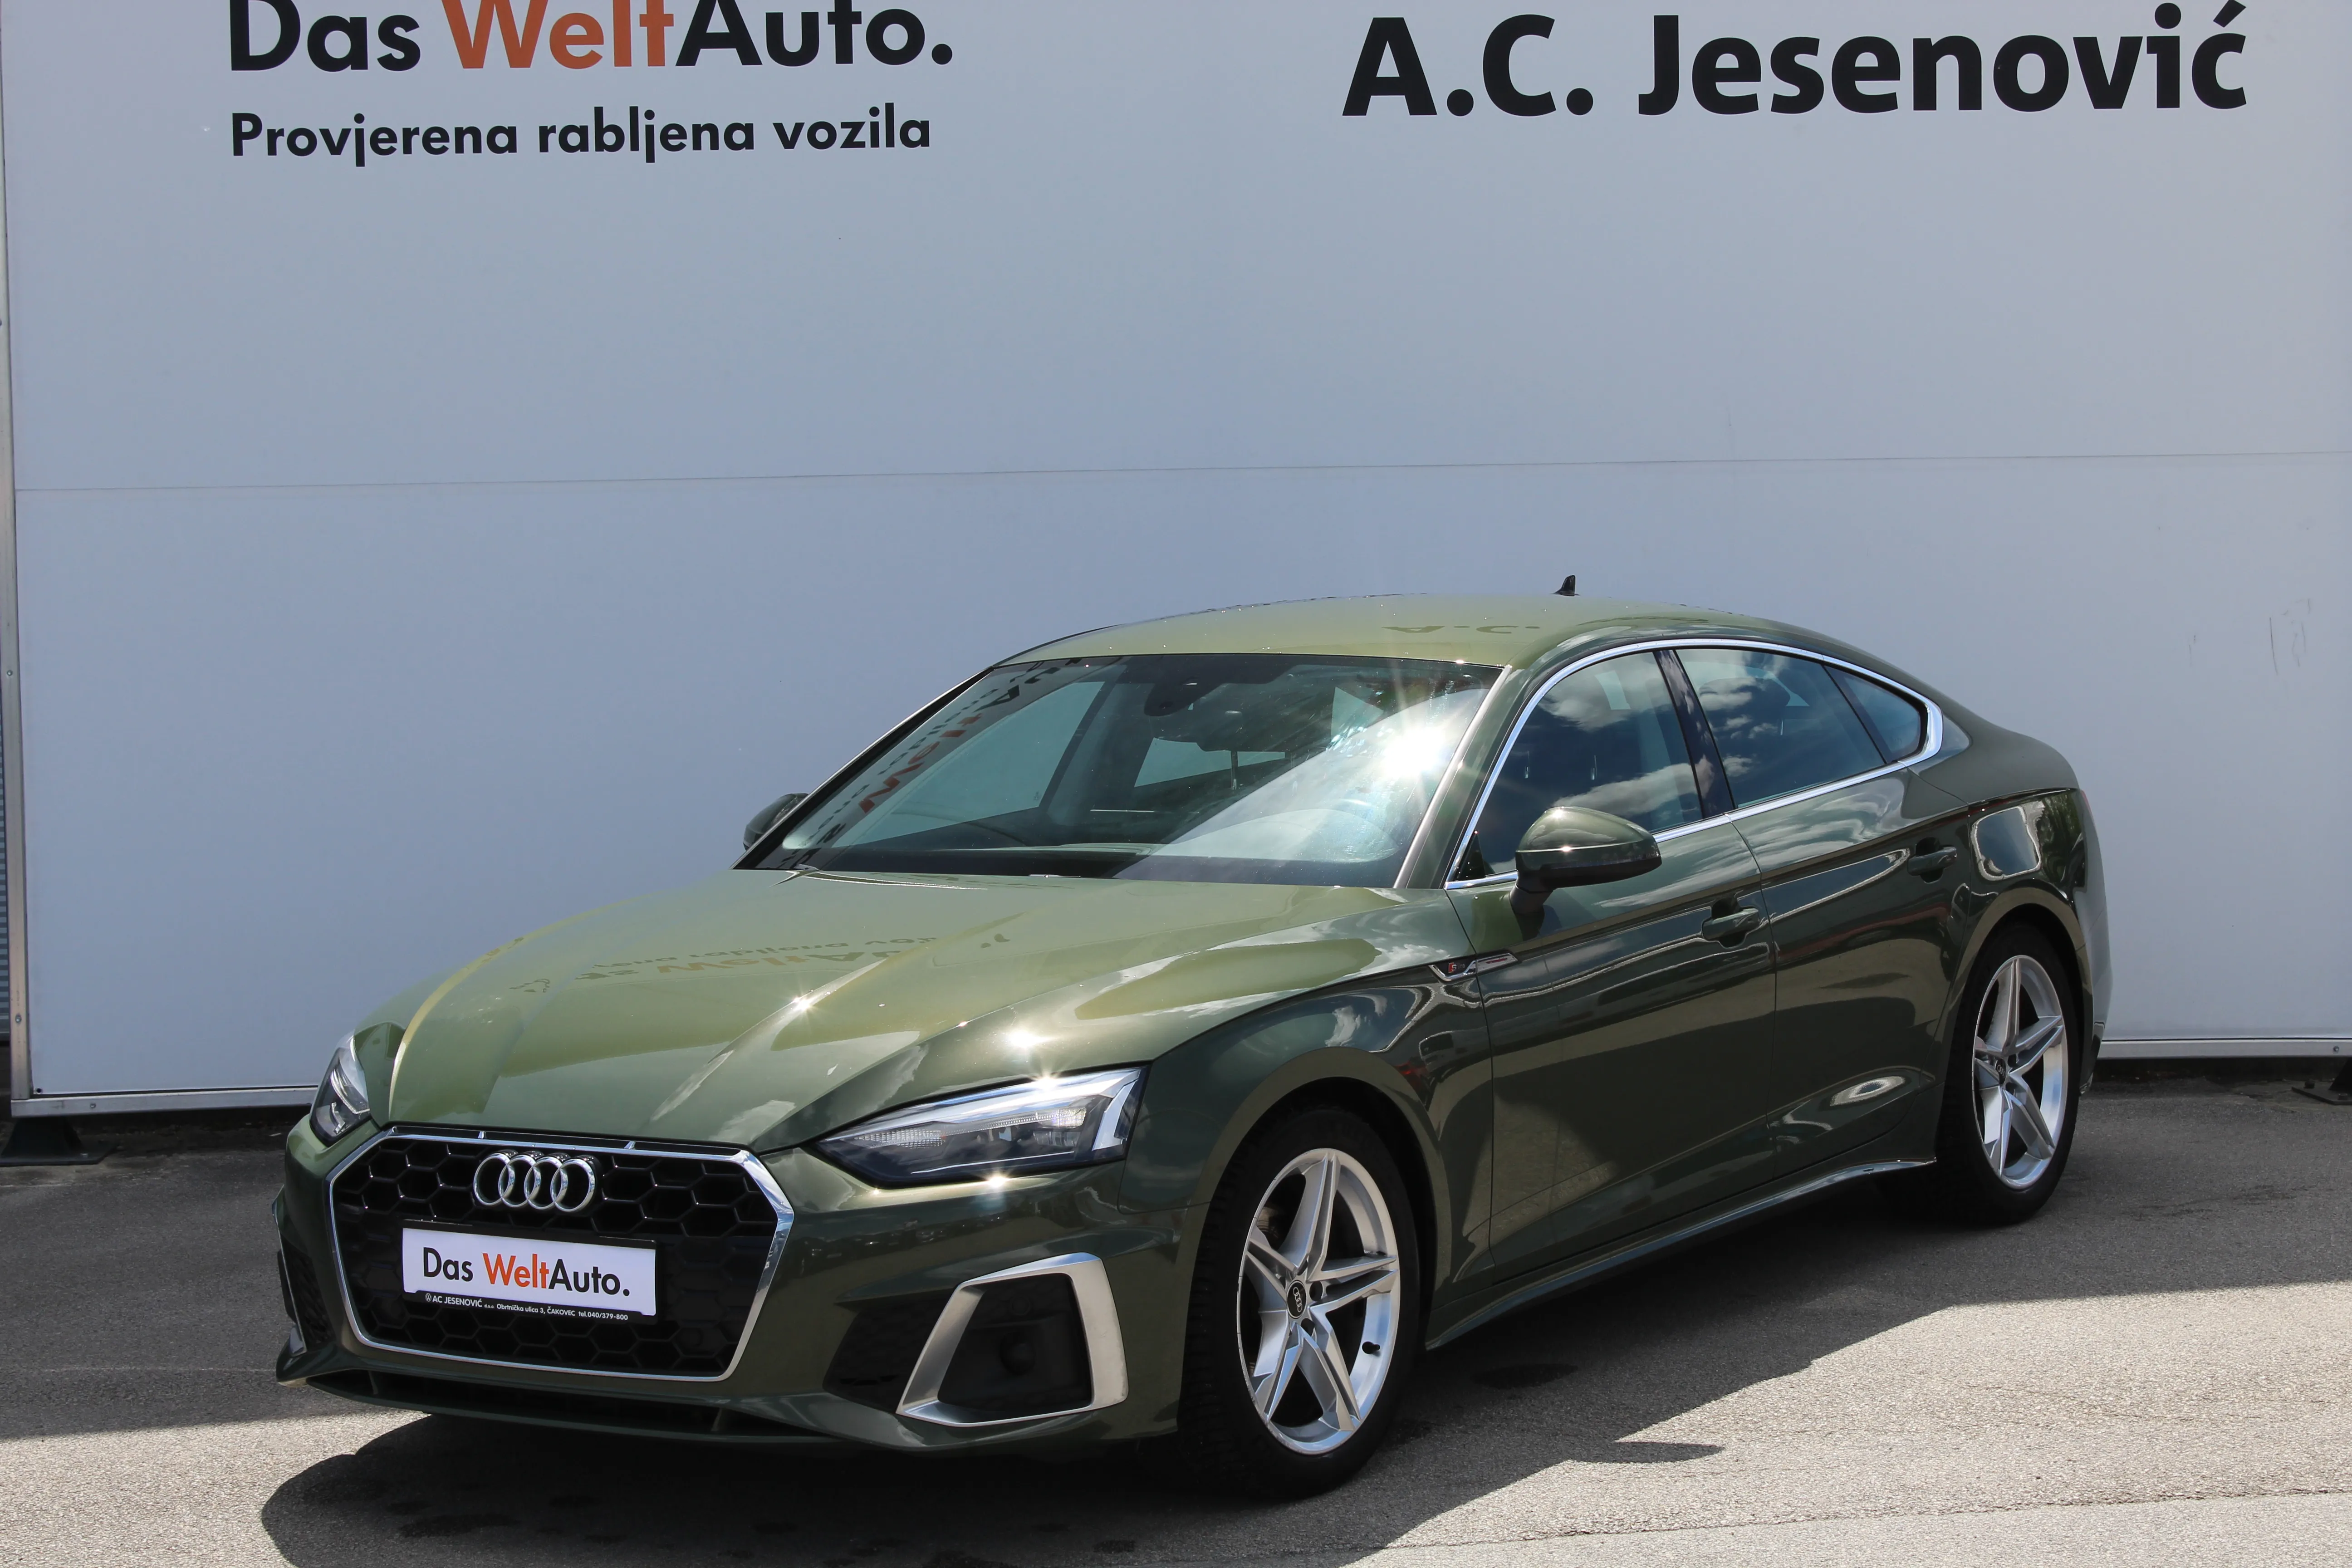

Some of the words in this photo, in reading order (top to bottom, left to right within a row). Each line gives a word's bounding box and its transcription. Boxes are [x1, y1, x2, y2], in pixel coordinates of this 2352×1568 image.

[230, 0, 420, 72] Das
[442, 0, 952, 69] WeltAuto.
[1343, 15, 1593, 116] A.C.
[1639, 0, 2246, 115] Jesenović
[232, 113, 517, 167] Provjerena
[539, 106, 754, 163] rabljena
[773, 103, 929, 149] vozila
[424, 1247, 473, 1282] Das
[482, 1253, 630, 1297] WeltAuto.
[444, 1297, 483, 1307] JESENOVIĆ
[547, 1306, 575, 1316] ČAKOVEC
